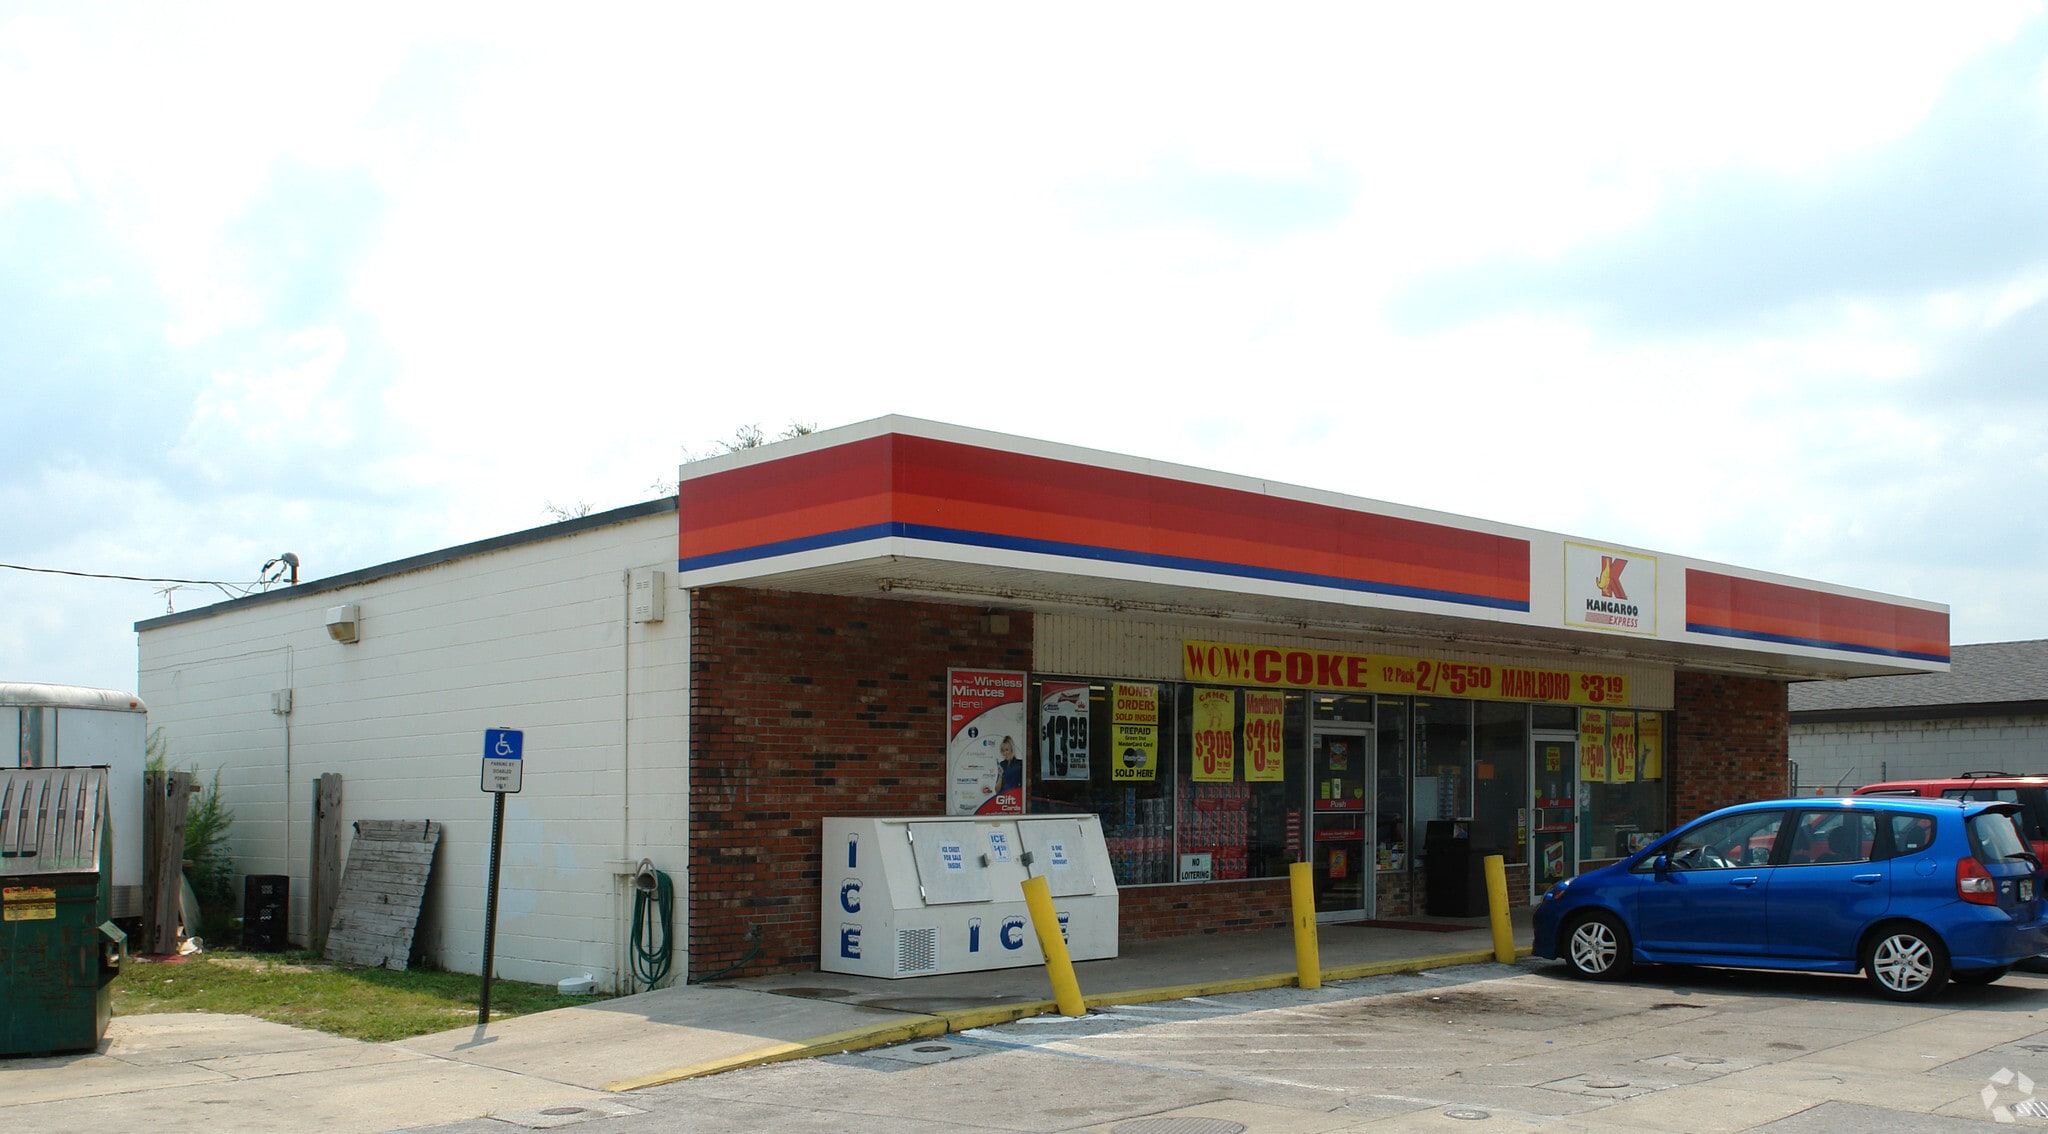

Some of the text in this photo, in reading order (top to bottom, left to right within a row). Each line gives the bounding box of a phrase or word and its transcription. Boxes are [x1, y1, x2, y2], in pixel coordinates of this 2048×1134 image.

[1586, 598, 1639, 617] KANGAROO
[1609, 615, 1639, 629] EXPRESS
[1187, 645, 1251, 680] WOW!
[1254, 650, 1368, 688] COKE
[1382, 667, 1394, 682] 12
[1395, 668, 1415, 684] Pack
[1501, 668, 1571, 701] MARLBORO
[974, 676, 1023, 688] Wireless
[952, 686, 1005, 698] Minutes
[1118, 684, 1155, 697] MONEY
[1199, 691, 1231, 704] CAMEL
[952, 700, 983, 709] Here!
[1117, 699, 1156, 712] ORDERS
[1246, 693, 1283, 715] Marlboro
[1115, 713, 1157, 722] SOLD INSIDE
[1612, 713, 1634, 729] Newport
[1120, 726, 1151, 736] PREPAID
[1115, 768, 1155, 778] SOLD HERE
[996, 795, 1017, 805] Gift
[1330, 800, 1347, 809] Push
[990, 834, 1006, 843] ICE
[1191, 858, 1201, 867] NO
[1181, 871, 1210, 880] LOITERING
